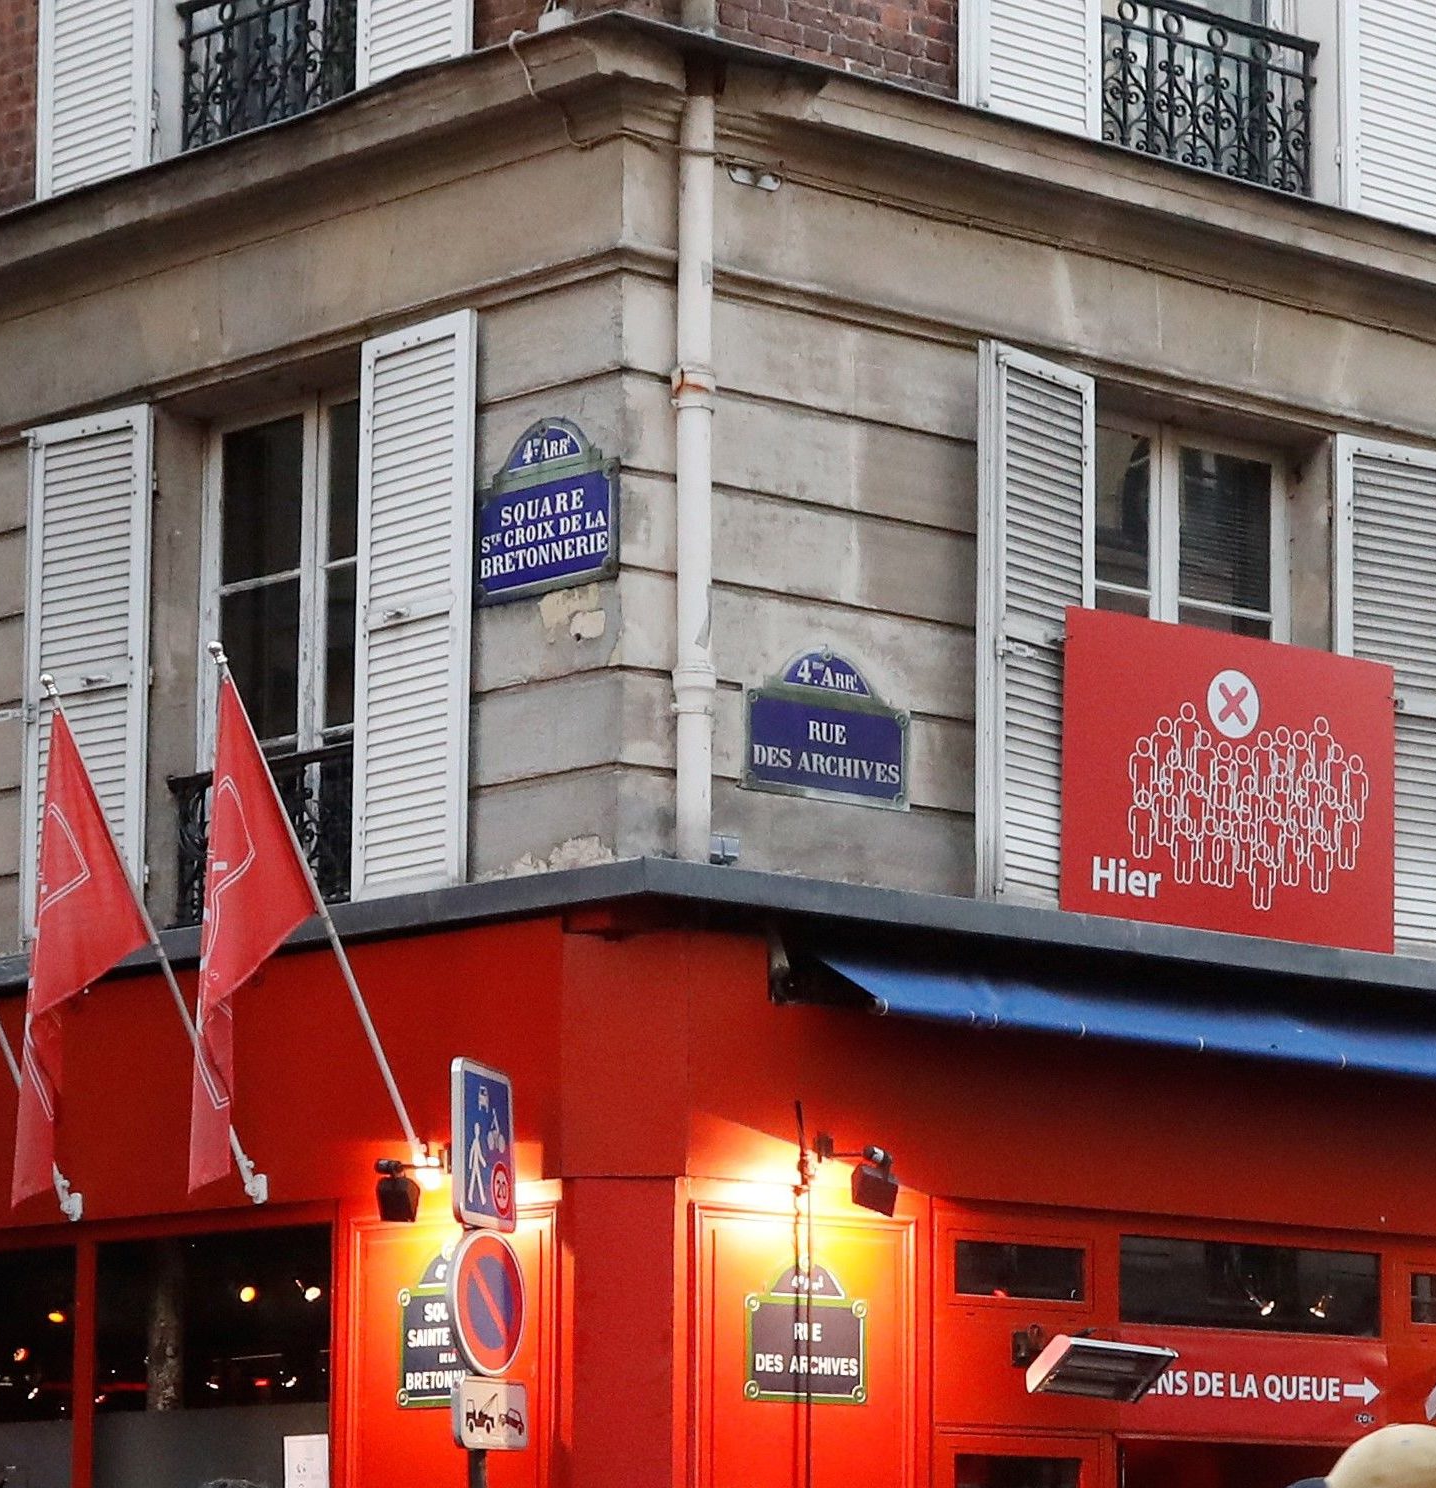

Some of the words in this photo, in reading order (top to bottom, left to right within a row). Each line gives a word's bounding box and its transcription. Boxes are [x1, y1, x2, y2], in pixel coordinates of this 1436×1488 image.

[501, 488, 584, 527] SQUARE
[504, 520, 555, 548] CROIX
[559, 514, 582, 536] DE
[585, 510, 607, 529] LA
[480, 531, 609, 579] BRETONNERIE
[808, 720, 847, 745] RUE
[753, 744, 792, 768] DES
[797, 751, 900, 784] ARCHIVES
[1092, 856, 1162, 898] Hier
[496, 1179, 506, 1199] 20
[424, 1302, 449, 1323] SQU
[407, 1327, 451, 1348] SAINTE
[755, 1353, 784, 1373] DES
[789, 1355, 859, 1377] ARCHIVES
[1194, 1371, 1225, 1398] DE
[1229, 1373, 1259, 1399] LA
[1263, 1374, 1341, 1402] QUEUE
